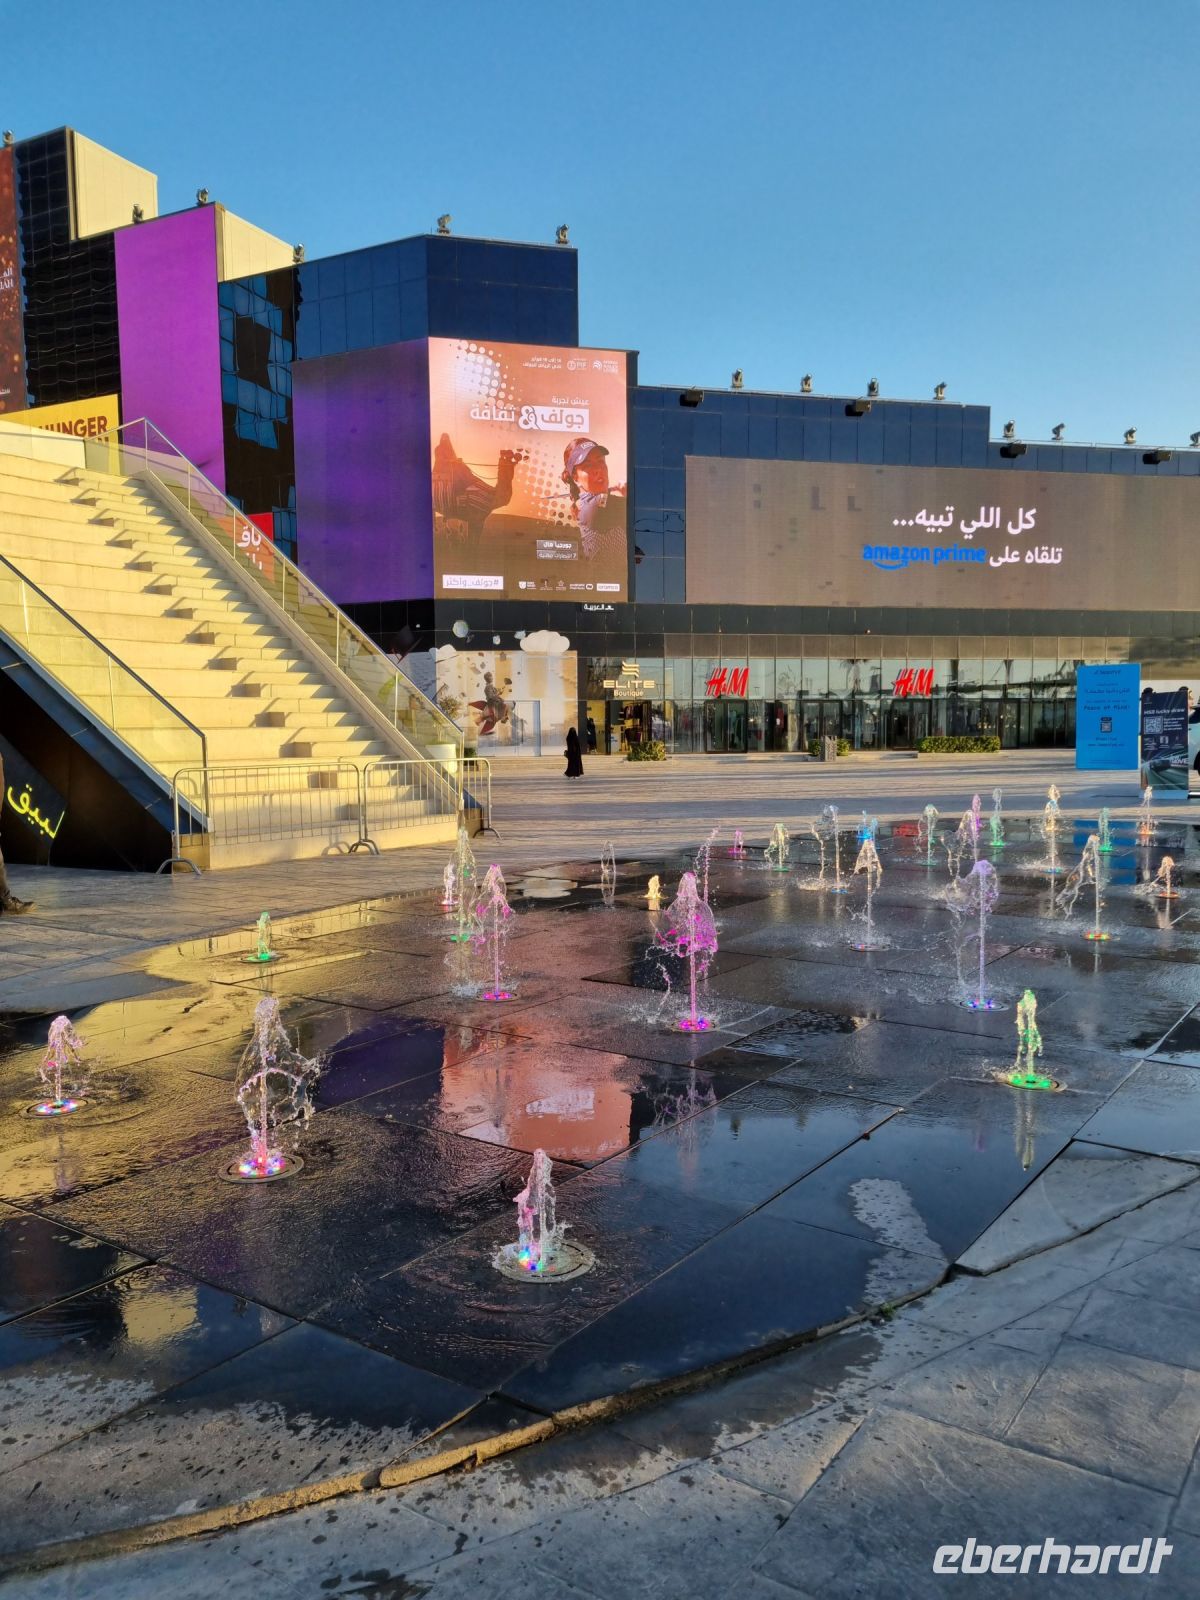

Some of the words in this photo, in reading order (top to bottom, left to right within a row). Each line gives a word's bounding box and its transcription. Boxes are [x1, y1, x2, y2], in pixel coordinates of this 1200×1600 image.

[470, 403, 516, 422] ثقافة
[541, 409, 585, 429] جولف
[38, 415, 108, 438] UNGER
[892, 506, 954, 533] تبيه...
[959, 506, 1000, 539] اللي
[1007, 508, 1037, 535] كل
[862, 544, 930, 564] amazon
[933, 544, 987, 564] prime
[989, 546, 1020, 567] على
[1024, 546, 1063, 565] تلقاه
[603, 680, 656, 689] ELITE
[706, 667, 749, 697] H&M
[892, 668, 934, 698] H&M
[613, 689, 644, 698] Boutique
